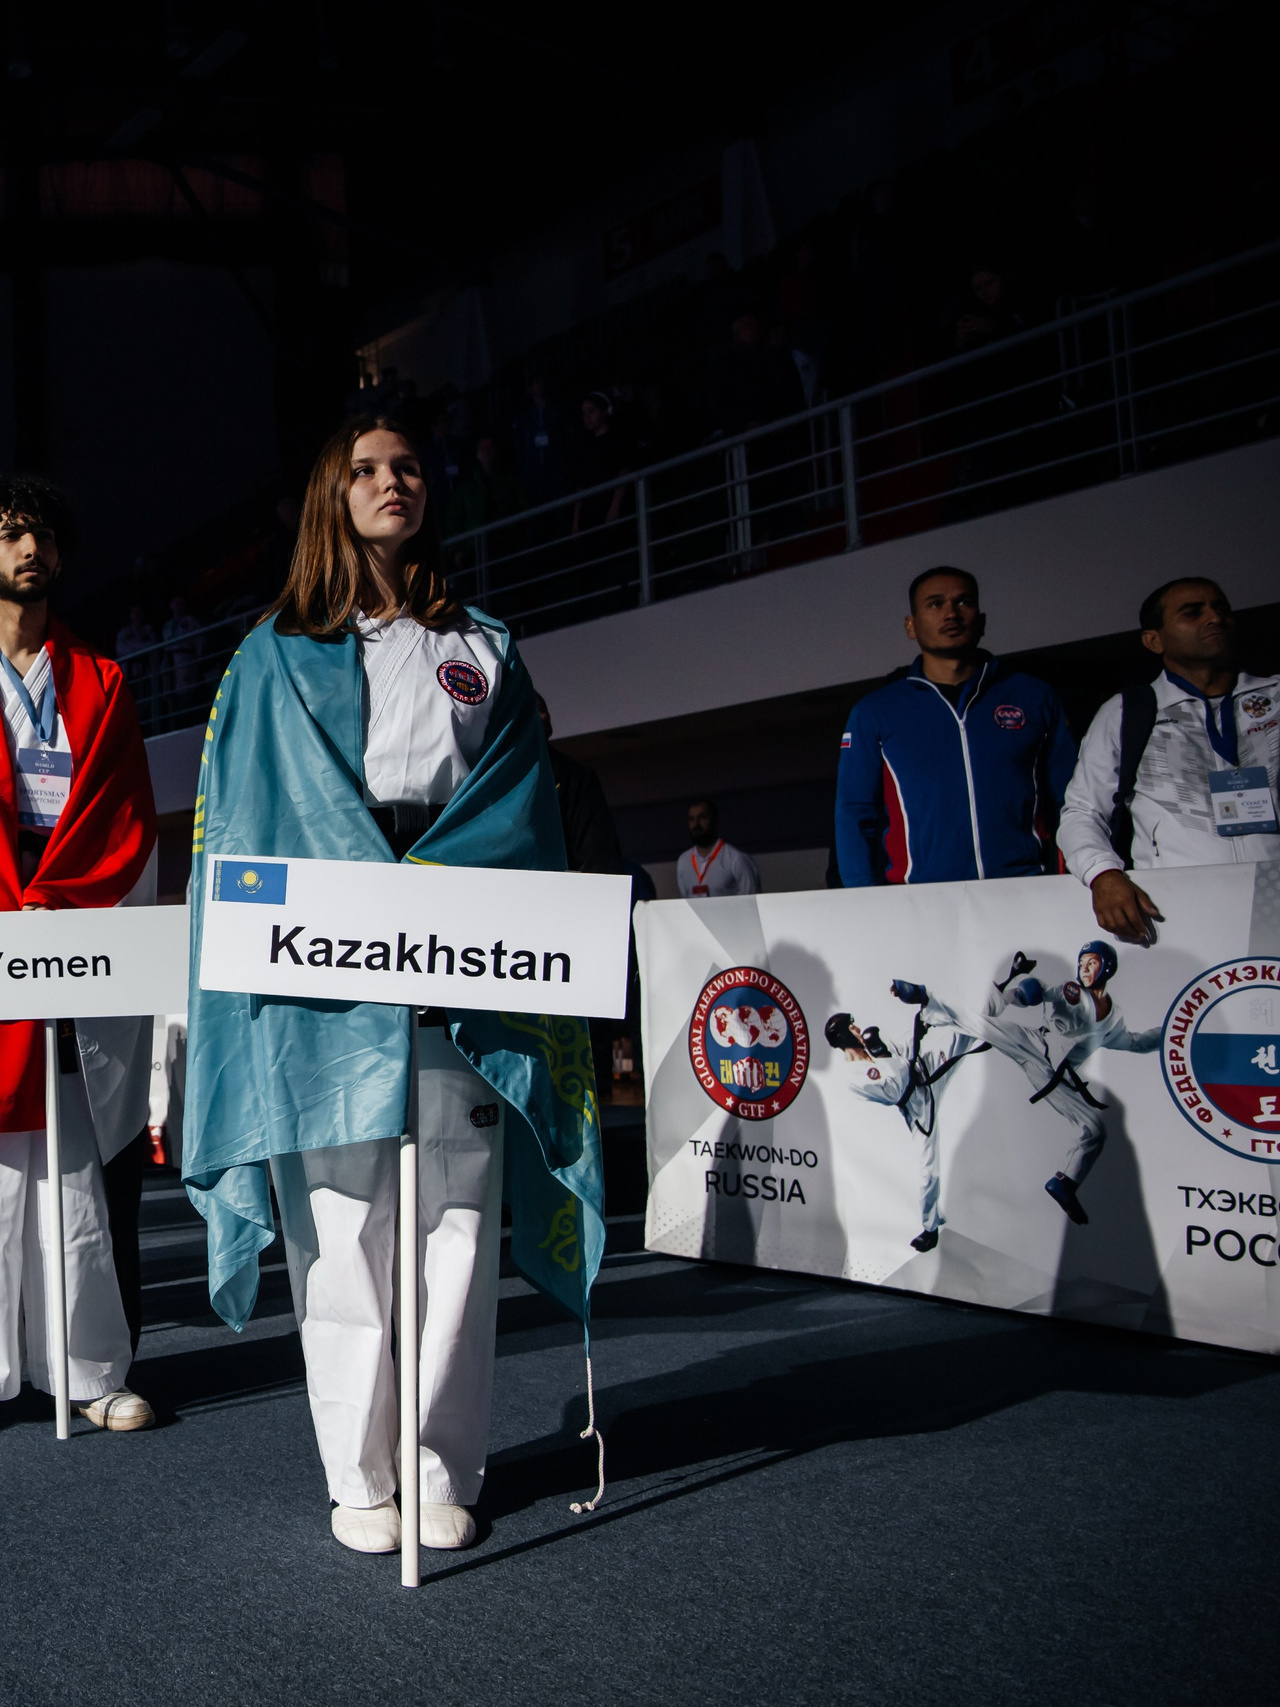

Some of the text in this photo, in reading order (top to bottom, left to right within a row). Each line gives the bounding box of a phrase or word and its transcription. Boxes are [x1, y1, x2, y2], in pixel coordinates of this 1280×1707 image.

[269, 924, 571, 983] Kazakhstan
[692, 970, 807, 1089] GLOBAL TAEKWON-DO FEDERATION
[1169, 964, 1280, 1123] ФЕДЕРАЦИЯ ТХЭК
[738, 1102, 766, 1118] GTF
[688, 1139, 818, 1168] TAEKWON-DO
[705, 1170, 806, 1205] RUSSIA
[1177, 1185, 1280, 1217] ТХЭКВ
[1186, 1225, 1280, 1267] РОС
